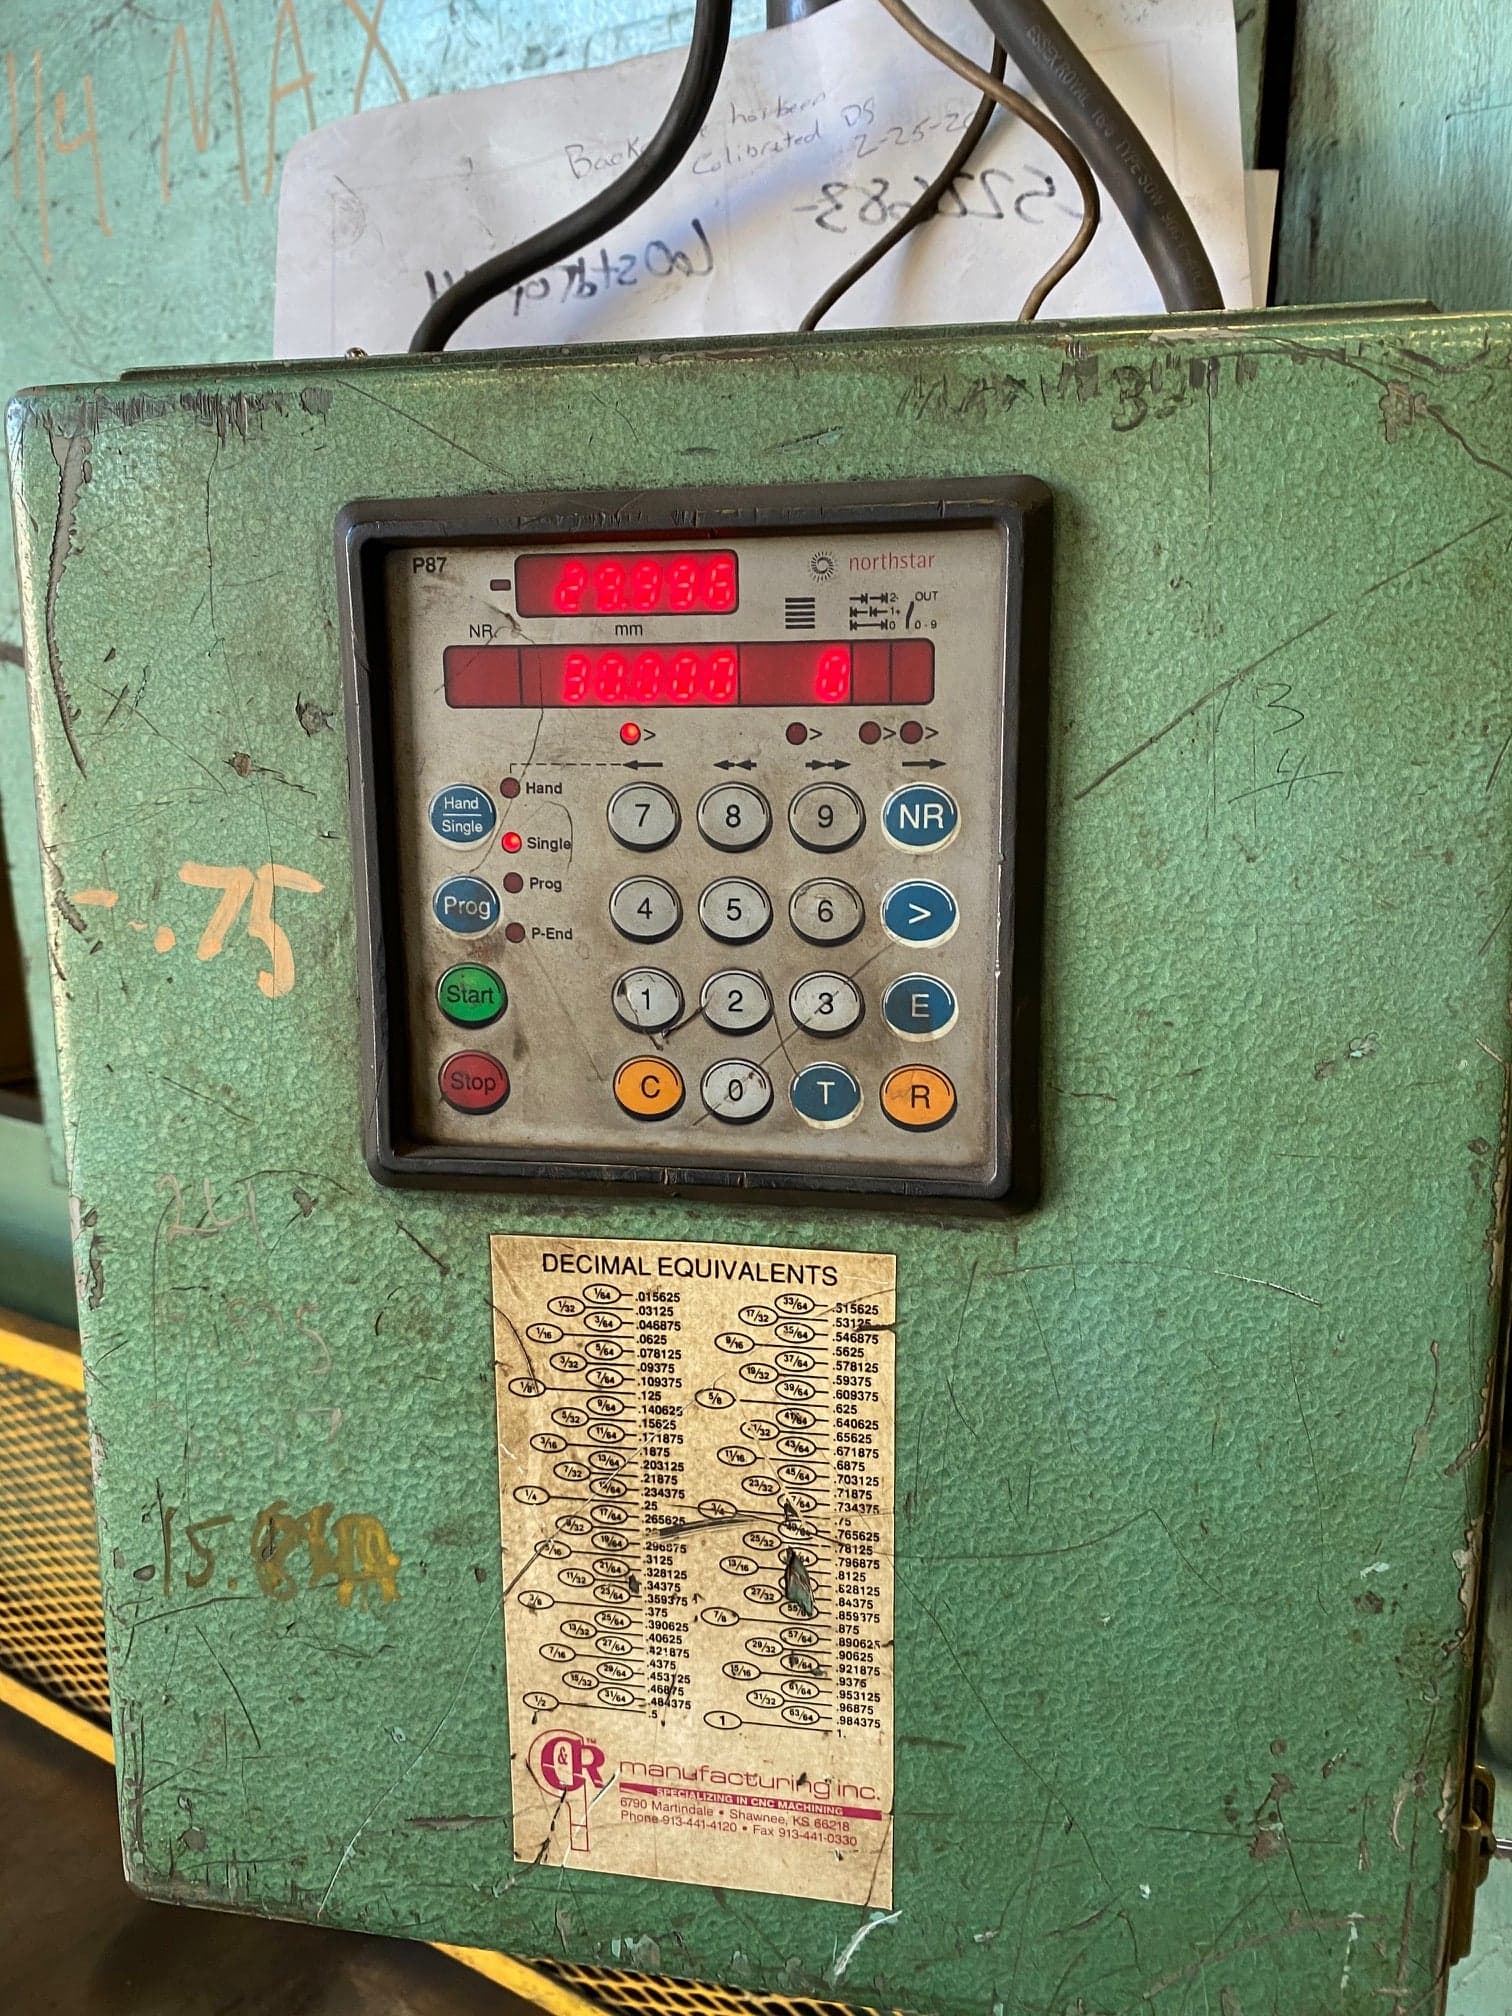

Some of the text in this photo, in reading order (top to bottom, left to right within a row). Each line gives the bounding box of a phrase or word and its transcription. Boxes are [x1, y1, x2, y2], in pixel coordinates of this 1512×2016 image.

[161, 0, 411, 205] MAX
[412, 556, 447, 574] P87
[849, 552, 936, 571] northstar
[914, 591, 939, 601] OUT
[468, 623, 495, 639] NR
[615, 623, 643, 636] mm
[814, 646, 851, 704] 0
[526, 781, 563, 796] Hand
[443, 796, 479, 811] Hand
[635, 803, 650, 828] 7
[725, 803, 742, 828] 8
[817, 803, 834, 828] 9
[899, 803, 944, 829] NR
[441, 818, 484, 835] Single
[527, 836, 572, 852] Single
[529, 877, 563, 894] Prog
[443, 896, 491, 921] Prog
[636, 896, 653, 920] 4
[726, 896, 742, 921] 5
[817, 898, 834, 923] 6
[531, 926, 573, 942] P-End
[446, 984, 495, 1006] Start
[641, 988, 652, 1012] 1
[727, 988, 744, 1012] 2
[817, 992, 834, 1016] 3
[911, 993, 930, 1018] E
[450, 1072, 497, 1096] Stop
[640, 1075, 660, 1099] C
[727, 1079, 743, 1102] 0
[817, 1081, 834, 1105] T
[911, 1083, 931, 1109] R
[542, 1253, 839, 1287] DECIMAL EQUIVALENTS
[593, 1287, 680, 1302] 1/64 .015625
[558, 1300, 673, 1316] 1/32 .03125
[782, 1296, 879, 1316] 33/64 .515625
[594, 1315, 681, 1331] 3/64 .046875
[746, 1309, 769, 1323] 17/32
[536, 1327, 667, 1344] 1/16 .0625
[833, 1331, 878, 1344] .546875
[595, 1344, 681, 1359] 5/64 .078125
[833, 1346, 864, 1358] .5625
[637, 1363, 674, 1373] .09375
[783, 1354, 879, 1374] 37/64 .578125
[638, 1377, 682, 1388] .109375
[746, 1366, 871, 1387] 19/32 .59375
[638, 1391, 661, 1401] .125
[783, 1383, 878, 1401] 39/64 .609375
[639, 1405, 682, 1416] .140625
[833, 1404, 857, 1414] .625
[561, 1411, 676, 1430] 5/32 .15625
[833, 1418, 878, 1430] .640625
[834, 1432, 872, 1444] .65625
[640, 1447, 670, 1457] .1875
[833, 1447, 880, 1459] .671875
[641, 1460, 684, 1471] .203125
[834, 1460, 865, 1471] .6875
[641, 1474, 677, 1485] .21875
[833, 1475, 880, 1487] .703125
[524, 1489, 657, 1510] 1/4 .25
[641, 1487, 686, 1499] .234375
[834, 1488, 872, 1500] .71875
[834, 1502, 879, 1515] .734375
[834, 1531, 880, 1543] .765625
[643, 1555, 673, 1565] .3125
[835, 1558, 880, 1570] .796875
[643, 1568, 688, 1580] .328125
[836, 1571, 865, 1582] .8125
[643, 1581, 681, 1593] .34375
[644, 1595, 689, 1607] .359375
[835, 1598, 874, 1610] .84375
[645, 1607, 667, 1617] .375
[835, 1611, 881, 1624] .859375
[646, 1620, 688, 1632] .390625
[835, 1624, 859, 1634] .875
[645, 1634, 683, 1645] .40625
[787, 1630, 812, 1643] 57/64
[602, 1638, 625, 1651] 27/64
[647, 1660, 676, 1669] .4375
[835, 1651, 874, 1663] .90625
[836, 1664, 881, 1677] .921875
[647, 1672, 691, 1685] .453125
[648, 1698, 692, 1710] .484375
[836, 1690, 881, 1703] .953125
[534, 1694, 657, 1718] 1/2 .5
[836, 1704, 874, 1715] .96875
[789, 1708, 881, 1729] 63/64 .984375
[837, 1730, 846, 1738] 1.
[620, 1760, 881, 1801] manufacturing inc.
[656, 1787, 844, 1817] SPECIALIZING IN CNC MACHINING
[620, 1797, 850, 1832] 6790 Martindale Shawnee, KS 66218
[620, 1810, 858, 1847] Phone 913-441-4120 Fax 913-441-0330
